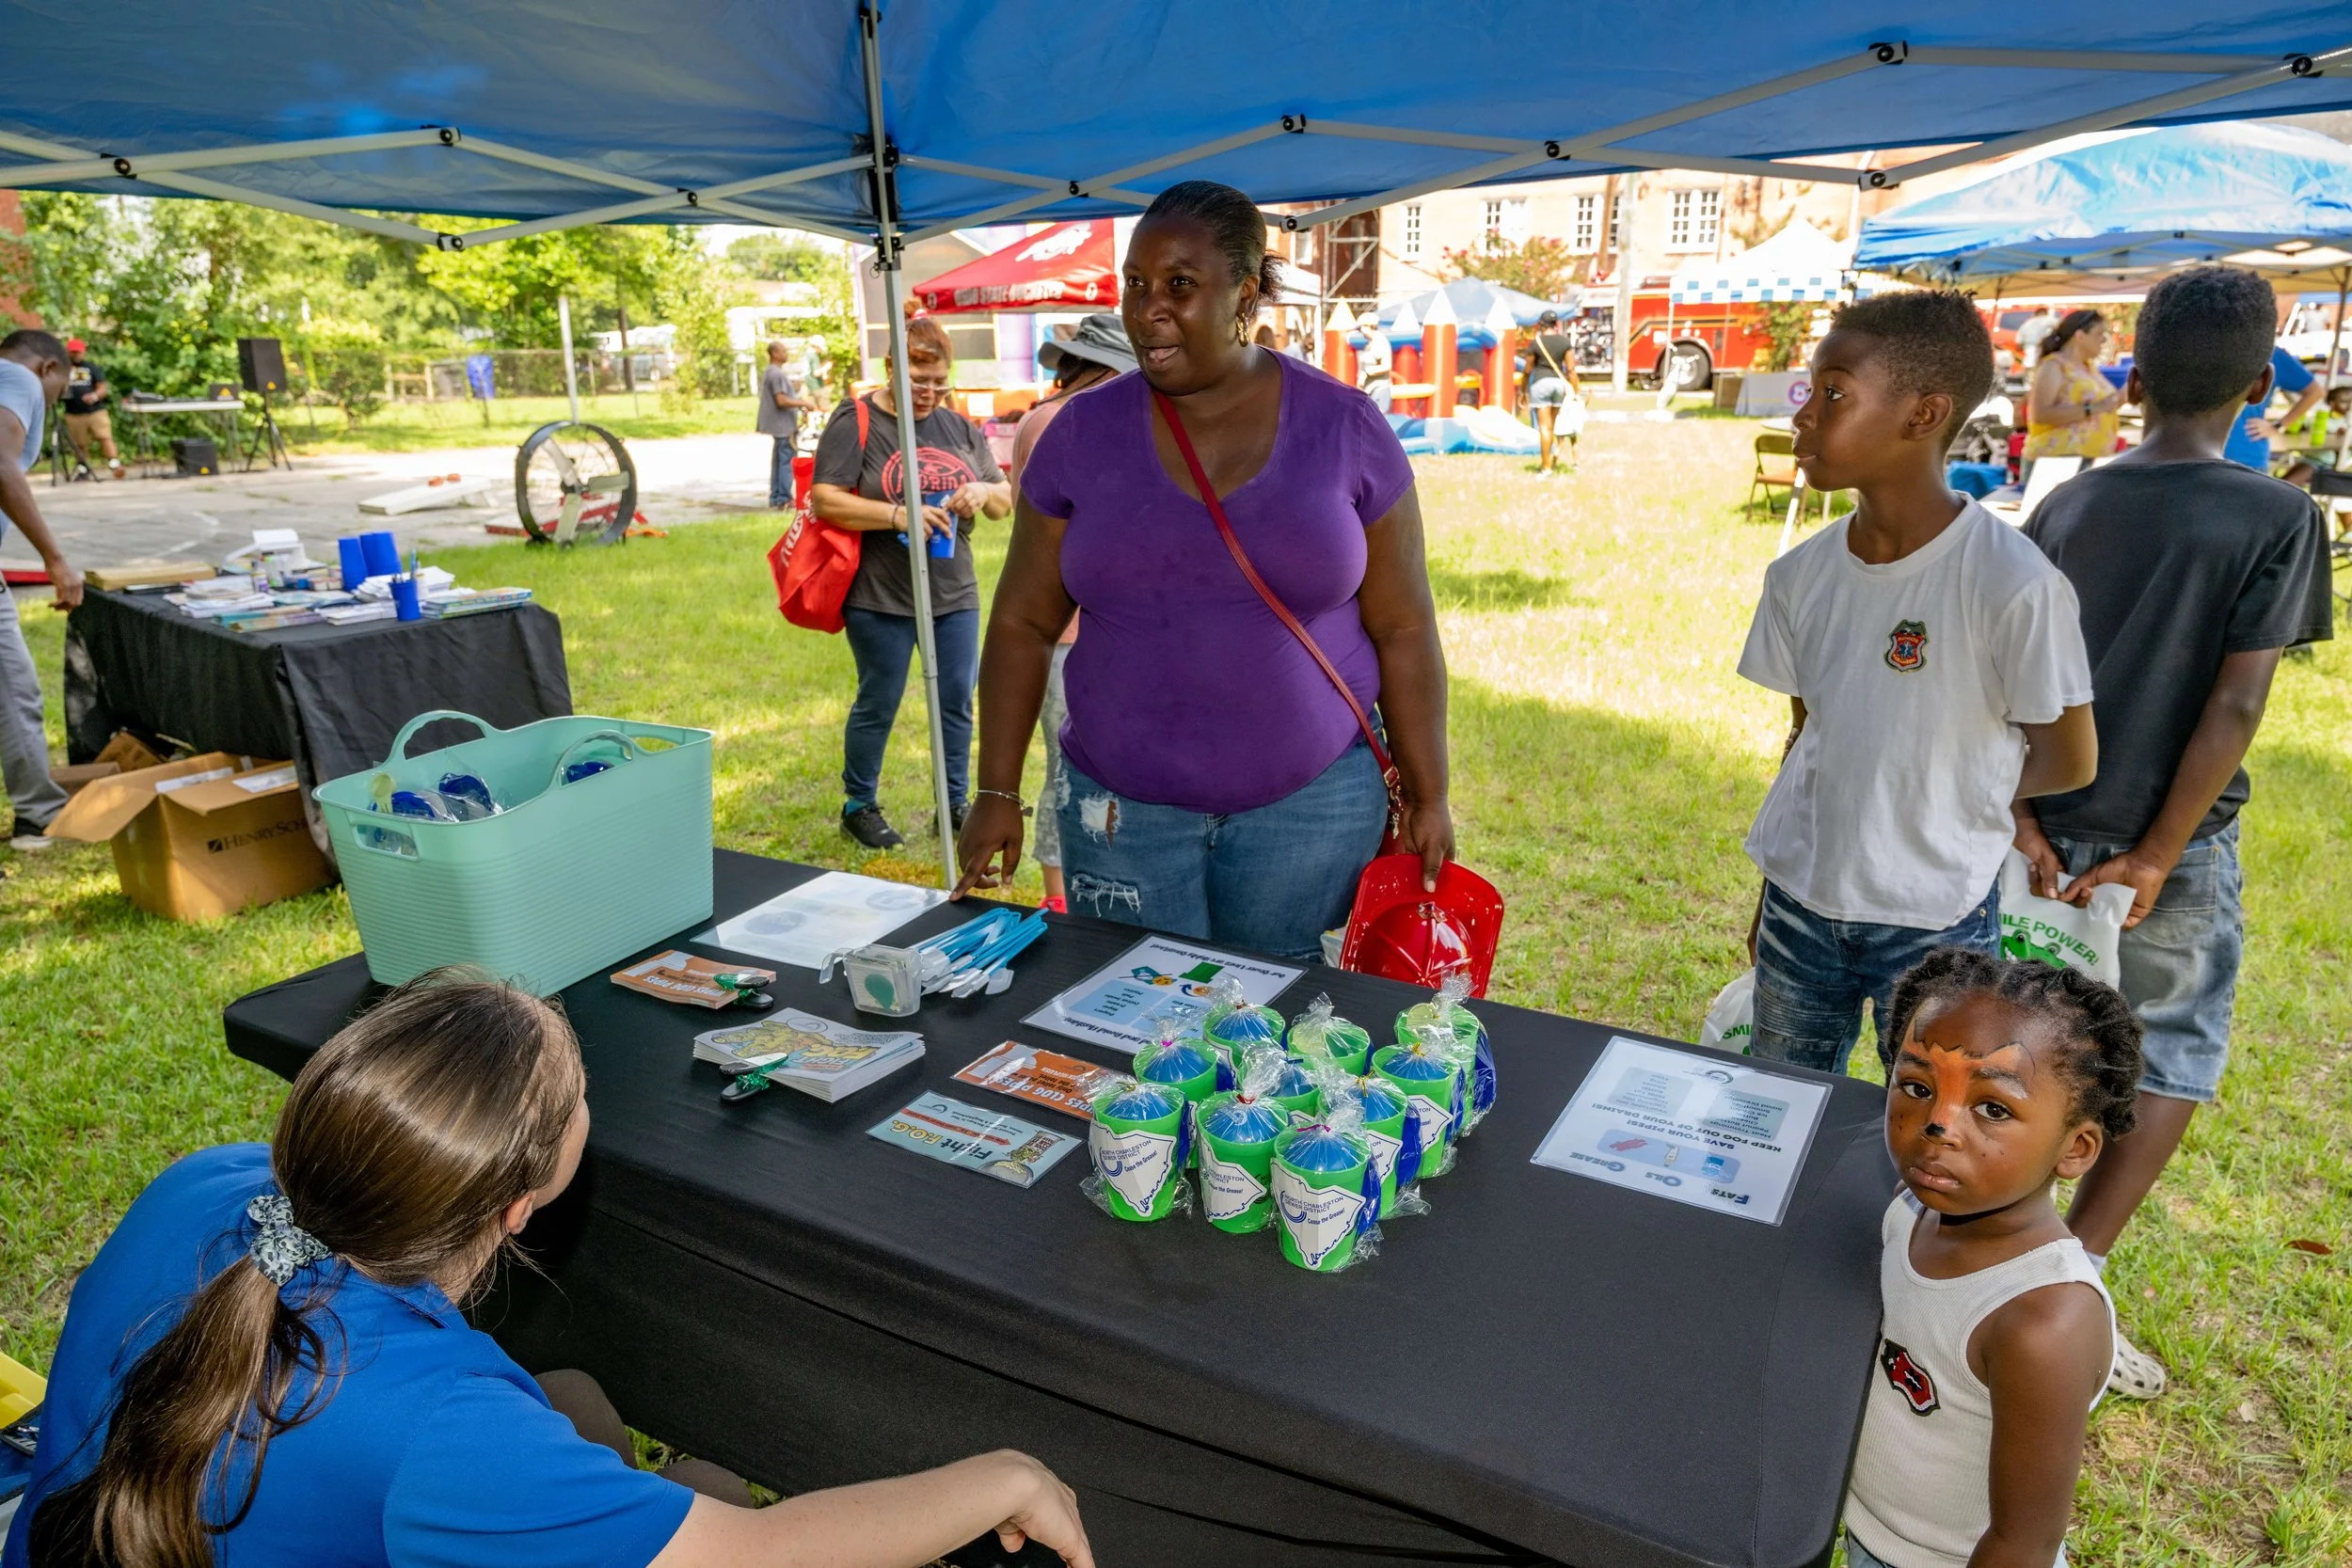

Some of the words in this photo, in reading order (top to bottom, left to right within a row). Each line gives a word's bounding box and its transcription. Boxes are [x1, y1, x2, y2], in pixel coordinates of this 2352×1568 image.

[2000, 913, 2030, 928] ILE
[2033, 921, 2100, 966] POWER!
[1037, 1080, 1057, 1088] toilet
[1032, 1086, 1065, 1101] CLOG
[1065, 1097, 1093, 1113] IPES
[1592, 1103, 1641, 1118] DRAINS!
[1626, 1119, 1665, 1133] PIPES!
[1643, 1115, 1675, 1127] YOUR
[890, 1120, 943, 1145] F.O.G.
[1667, 1129, 1700, 1142] YOUR
[1696, 1128, 1721, 1138] OUT
[1722, 1134, 1748, 1145] FOG
[940, 1138, 993, 1161] Fight
[1116, 1140, 1152, 1155] CHARLESTON
[1704, 1138, 1736, 1149] SAVE
[1751, 1141, 1782, 1152] KEEP
[1118, 1151, 1140, 1160] DISTRICT
[1142, 1150, 1157, 1164] Grease!
[1569, 1151, 1627, 1173] GREASE
[1645, 1172, 1682, 1187] OILS
[1284, 1195, 1302, 1204] NORTH
[1303, 1196, 1343, 1209] CHARLESTON
[1711, 1188, 1750, 1205] FATS
[1284, 1199, 1302, 1209] SEWER
[1329, 1208, 1345, 1219] Grease!
